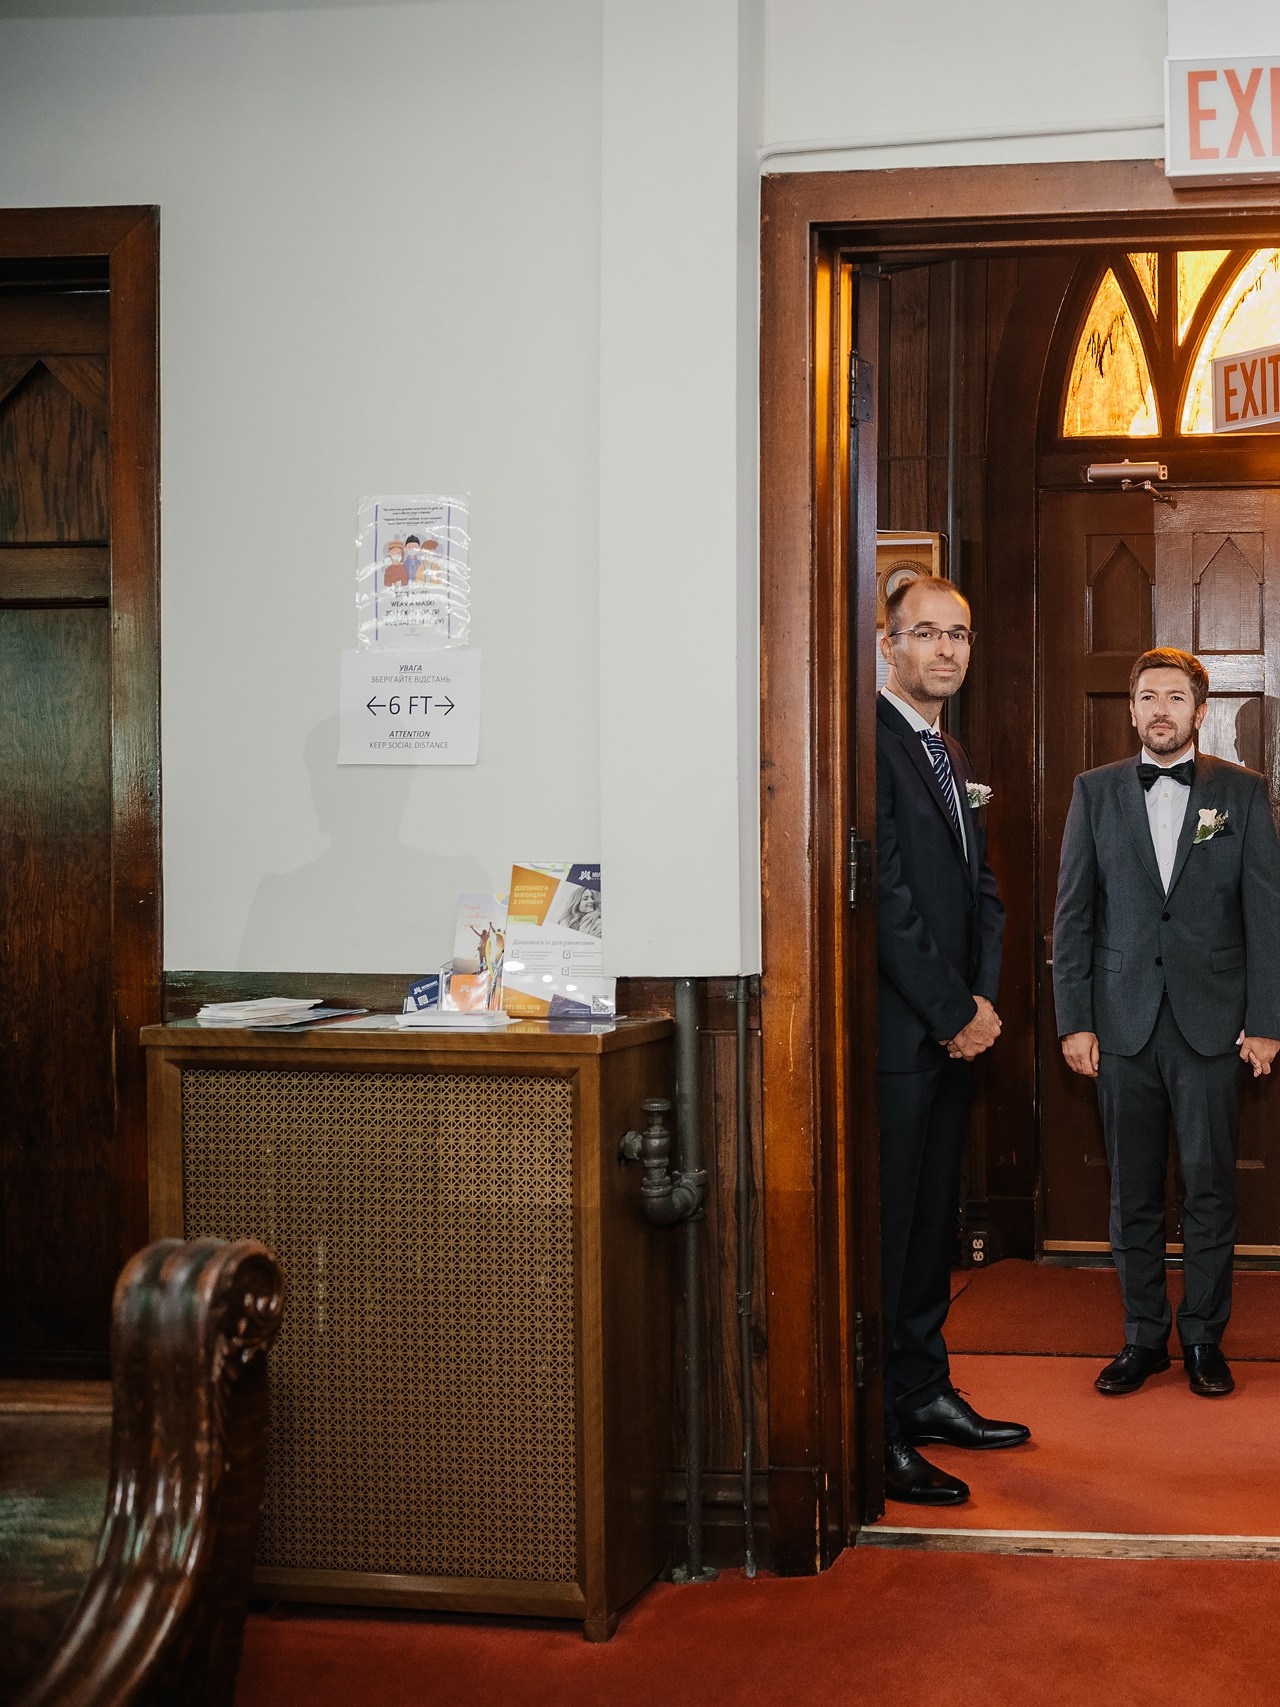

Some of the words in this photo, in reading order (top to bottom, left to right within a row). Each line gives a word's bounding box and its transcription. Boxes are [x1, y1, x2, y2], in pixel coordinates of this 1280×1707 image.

[371, 674, 413, 683] ЗБЕРІГАЙТЕ
[415, 675, 451, 684] ВІДСТАНЬ
[389, 696, 401, 715] 6
[409, 696, 433, 715] FT
[414, 741, 449, 749] DISTANCE
